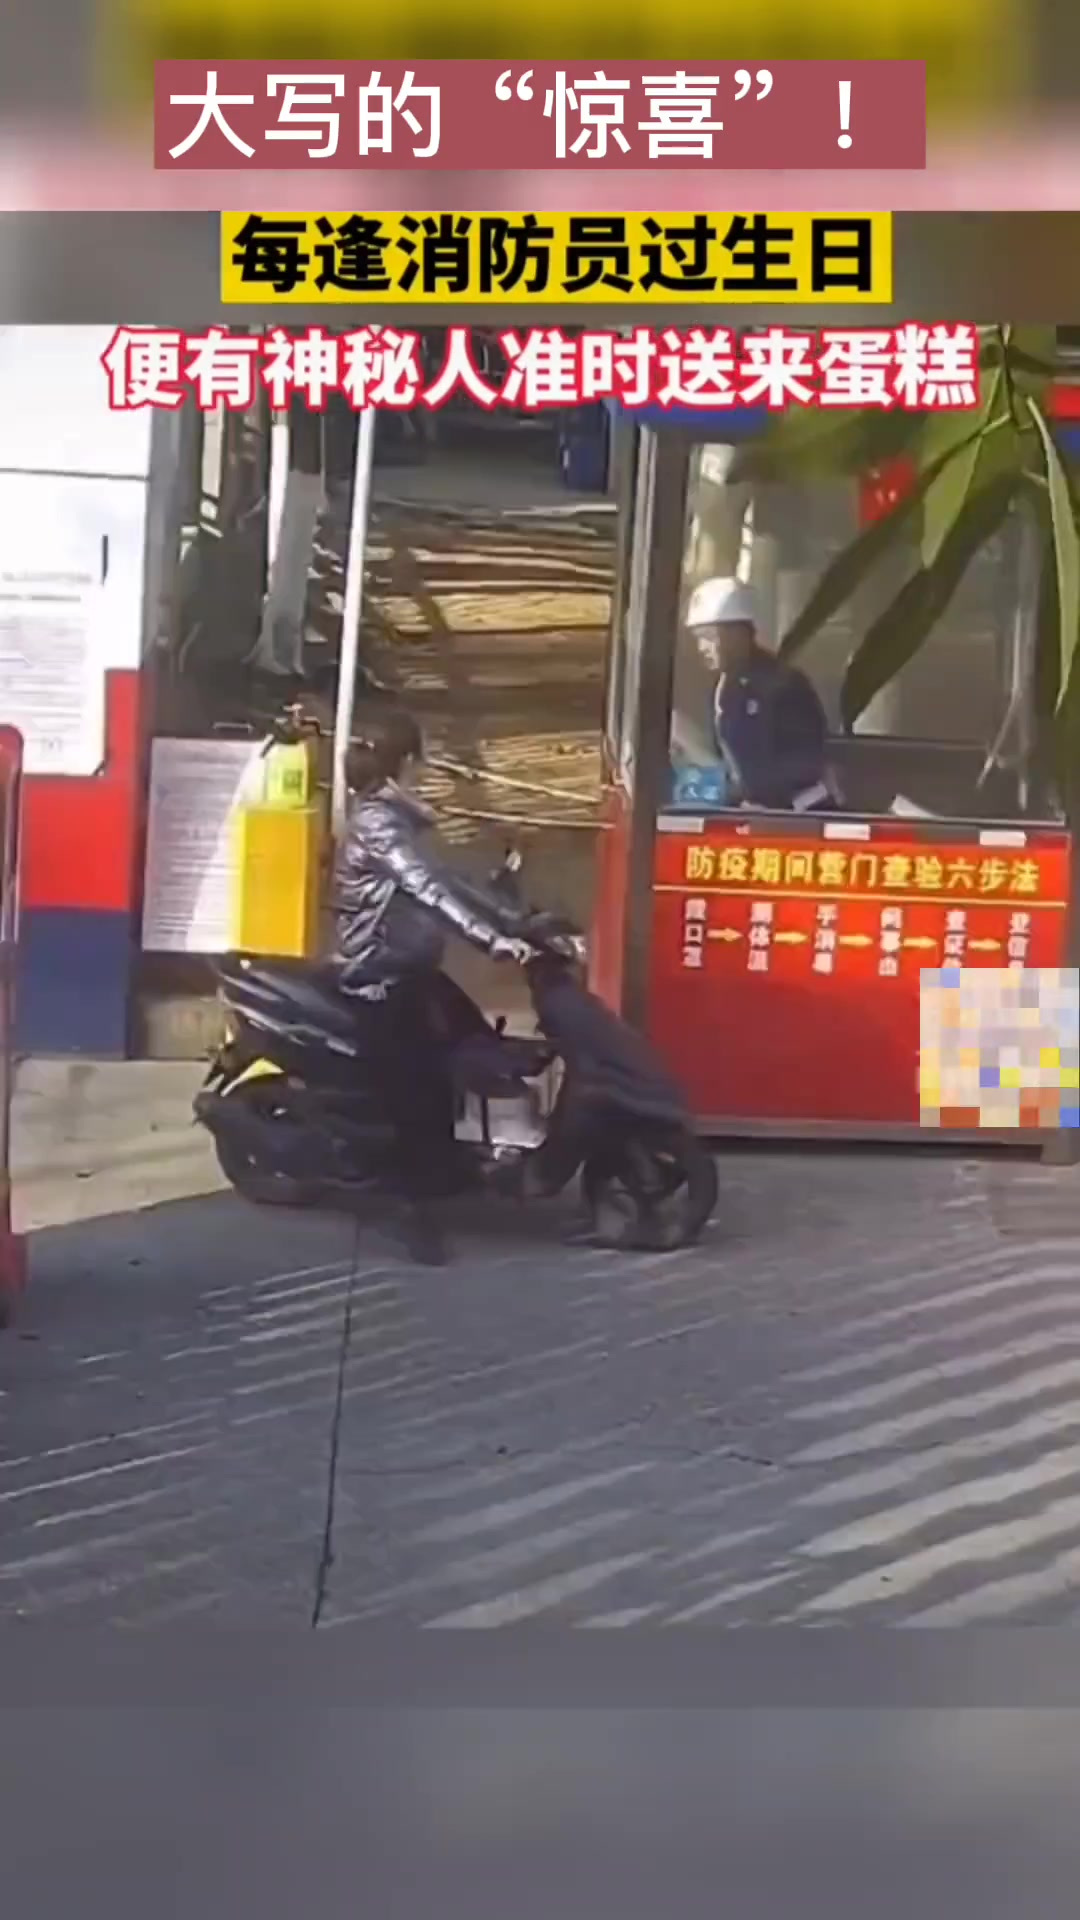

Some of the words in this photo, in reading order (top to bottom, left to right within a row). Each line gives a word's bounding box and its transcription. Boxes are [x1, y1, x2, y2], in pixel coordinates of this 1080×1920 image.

[685, 845, 1040, 893] 防疫期间营门查验六步法
